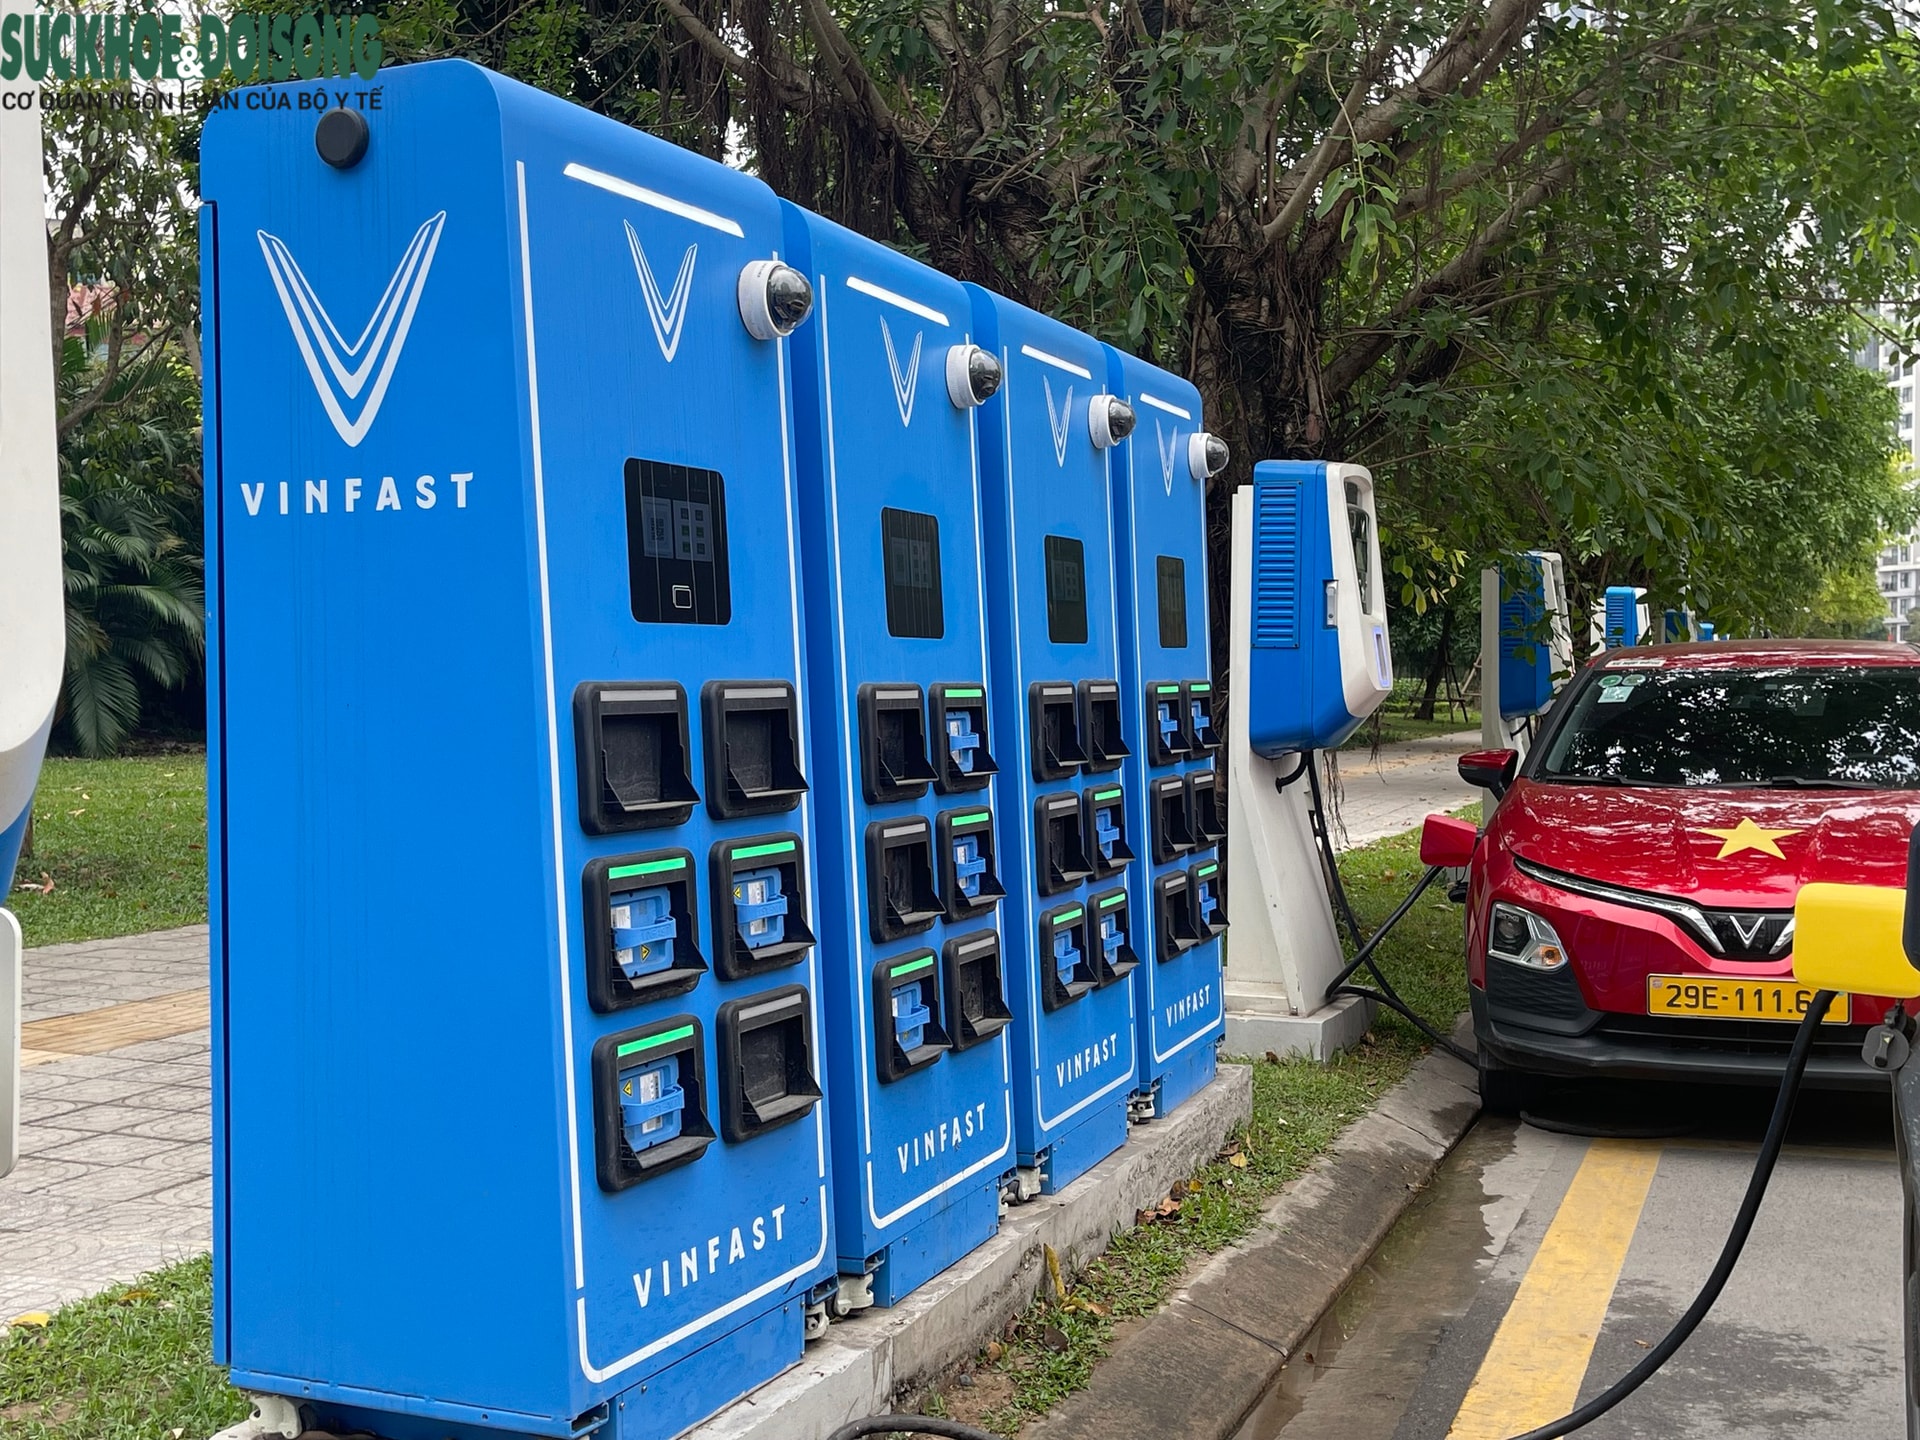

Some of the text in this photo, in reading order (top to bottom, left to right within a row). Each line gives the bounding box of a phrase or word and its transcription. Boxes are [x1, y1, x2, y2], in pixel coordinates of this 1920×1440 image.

[241, 472, 473, 516] VINFAST
[1166, 984, 1210, 1027] VINFAST
[1665, 984, 1831, 1014] 29E-111.6
[1056, 1033, 1117, 1088] VINFAST
[897, 1102, 986, 1174] VINFAST
[632, 1204, 786, 1308] VINFAST
